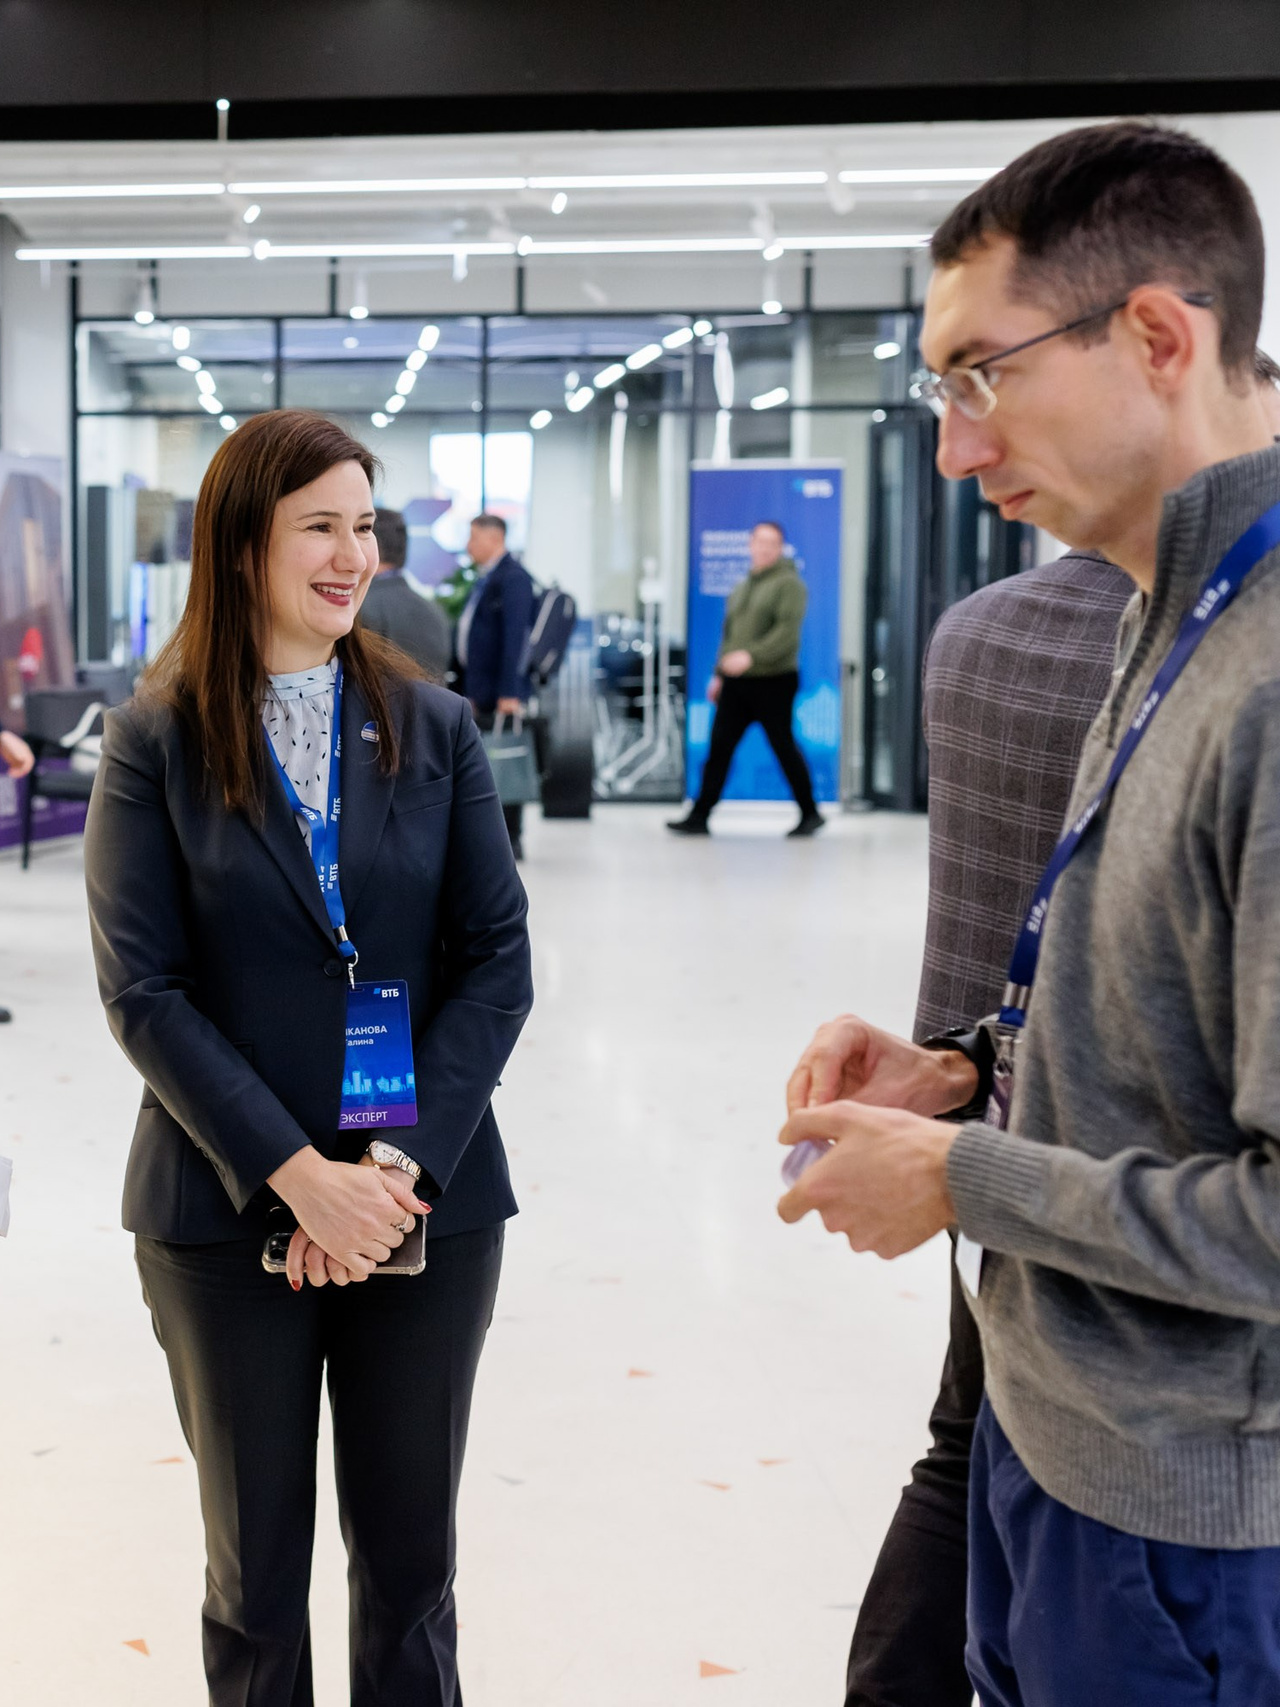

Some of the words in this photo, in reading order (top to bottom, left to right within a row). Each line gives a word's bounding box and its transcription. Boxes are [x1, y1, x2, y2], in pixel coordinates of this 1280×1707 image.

[329, 863, 339, 882] ВТБ
[381, 988, 400, 998] ВТБ
[345, 1025, 388, 1036] КАНОВА
[345, 1038, 374, 1046] алина
[340, 1111, 388, 1124] ЭКСПЕРТ
